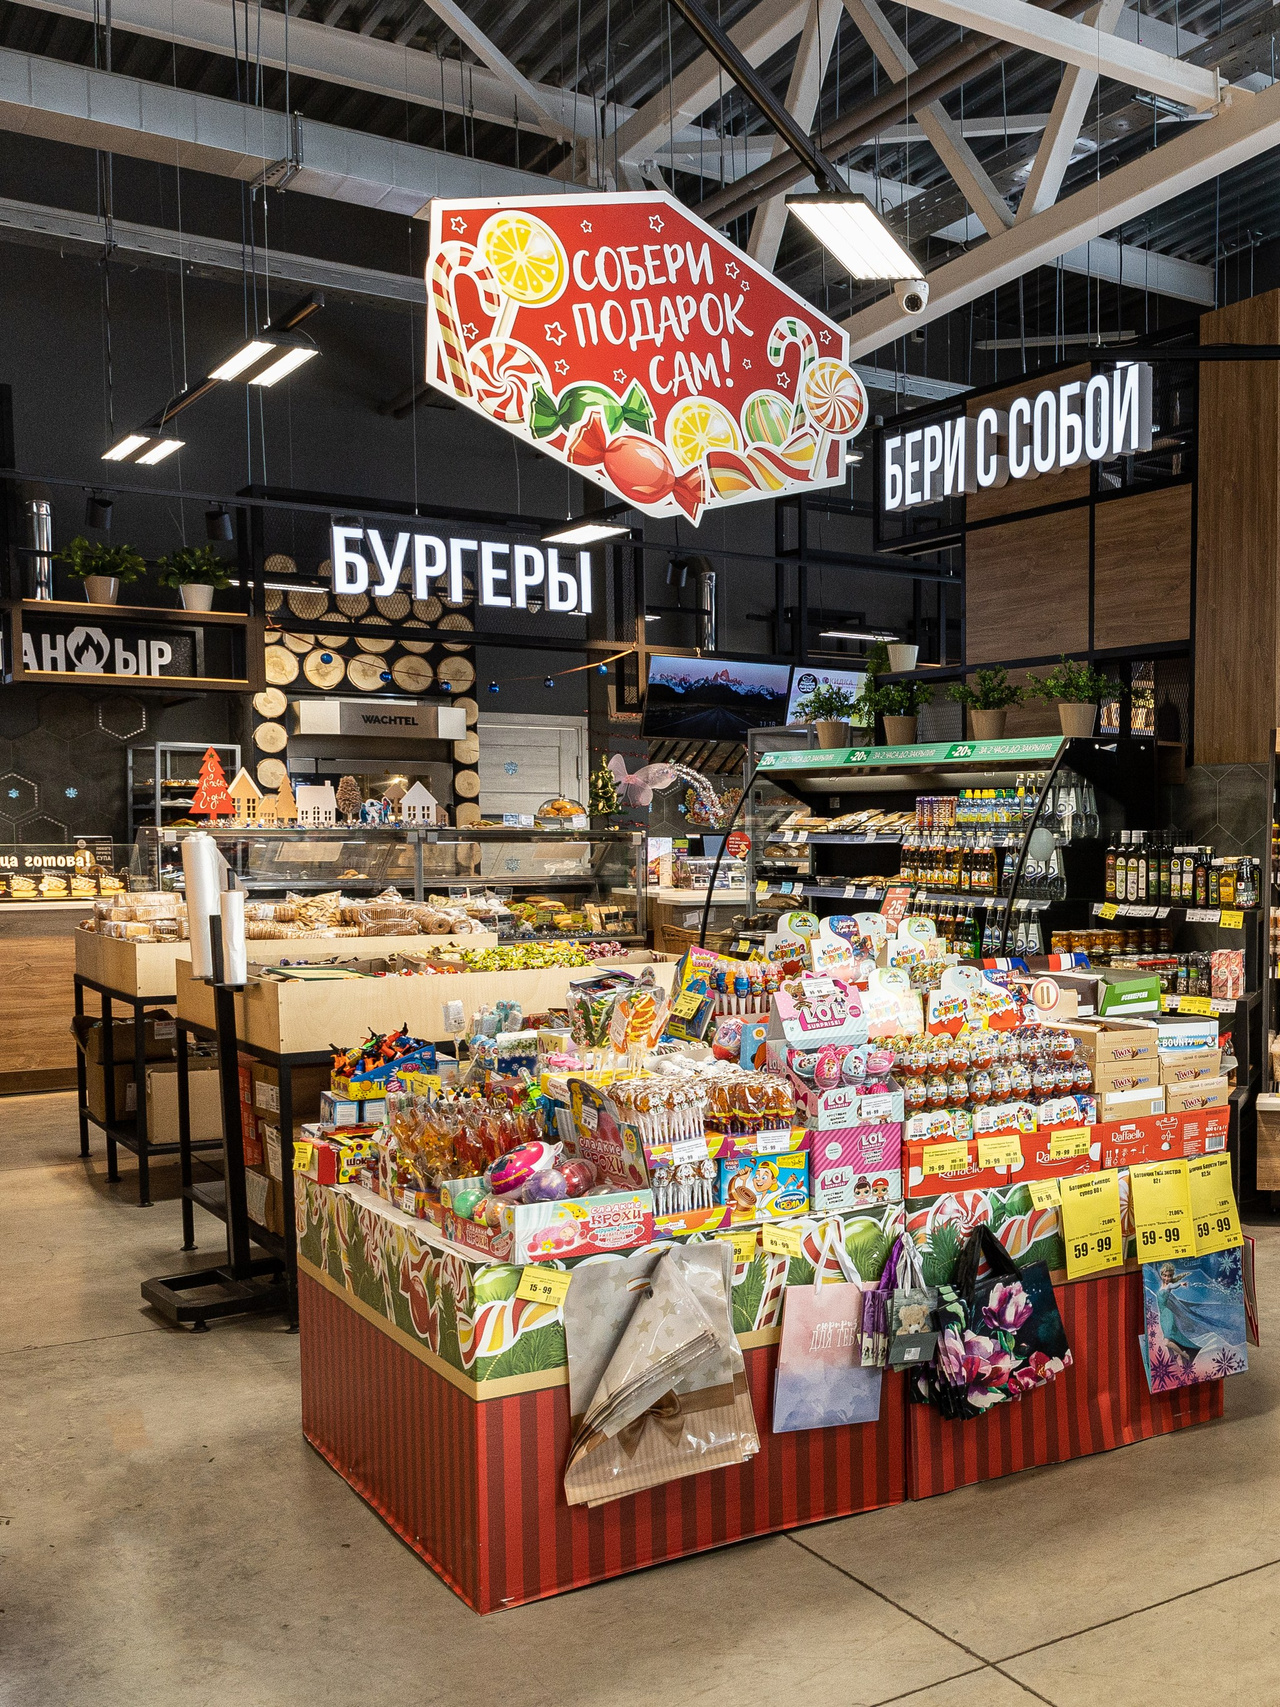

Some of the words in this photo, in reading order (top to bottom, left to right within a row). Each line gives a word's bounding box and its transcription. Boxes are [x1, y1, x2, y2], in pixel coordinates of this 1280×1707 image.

[573, 240, 714, 291] СОБЕРИ
[572, 293, 754, 352] ПОДАРОК
[649, 338, 734, 397] САМ!
[885, 416, 965, 511] БЕРИ
[976, 408, 1001, 487] С
[1009, 361, 1143, 479] СОБОЙ
[331, 525, 593, 614] БУРГЕРЫ
[361, 714, 419, 726] WACHTEL
[24, 854, 91, 868] готова!
[1162, 1038, 1193, 1047] BOUNTY
[625, 1132, 634, 1142] 12
[1111, 1129, 1145, 1142] Raffaello
[590, 1209, 643, 1226] КРОХИ
[809, 1329, 833, 1352] ДЛЯ
